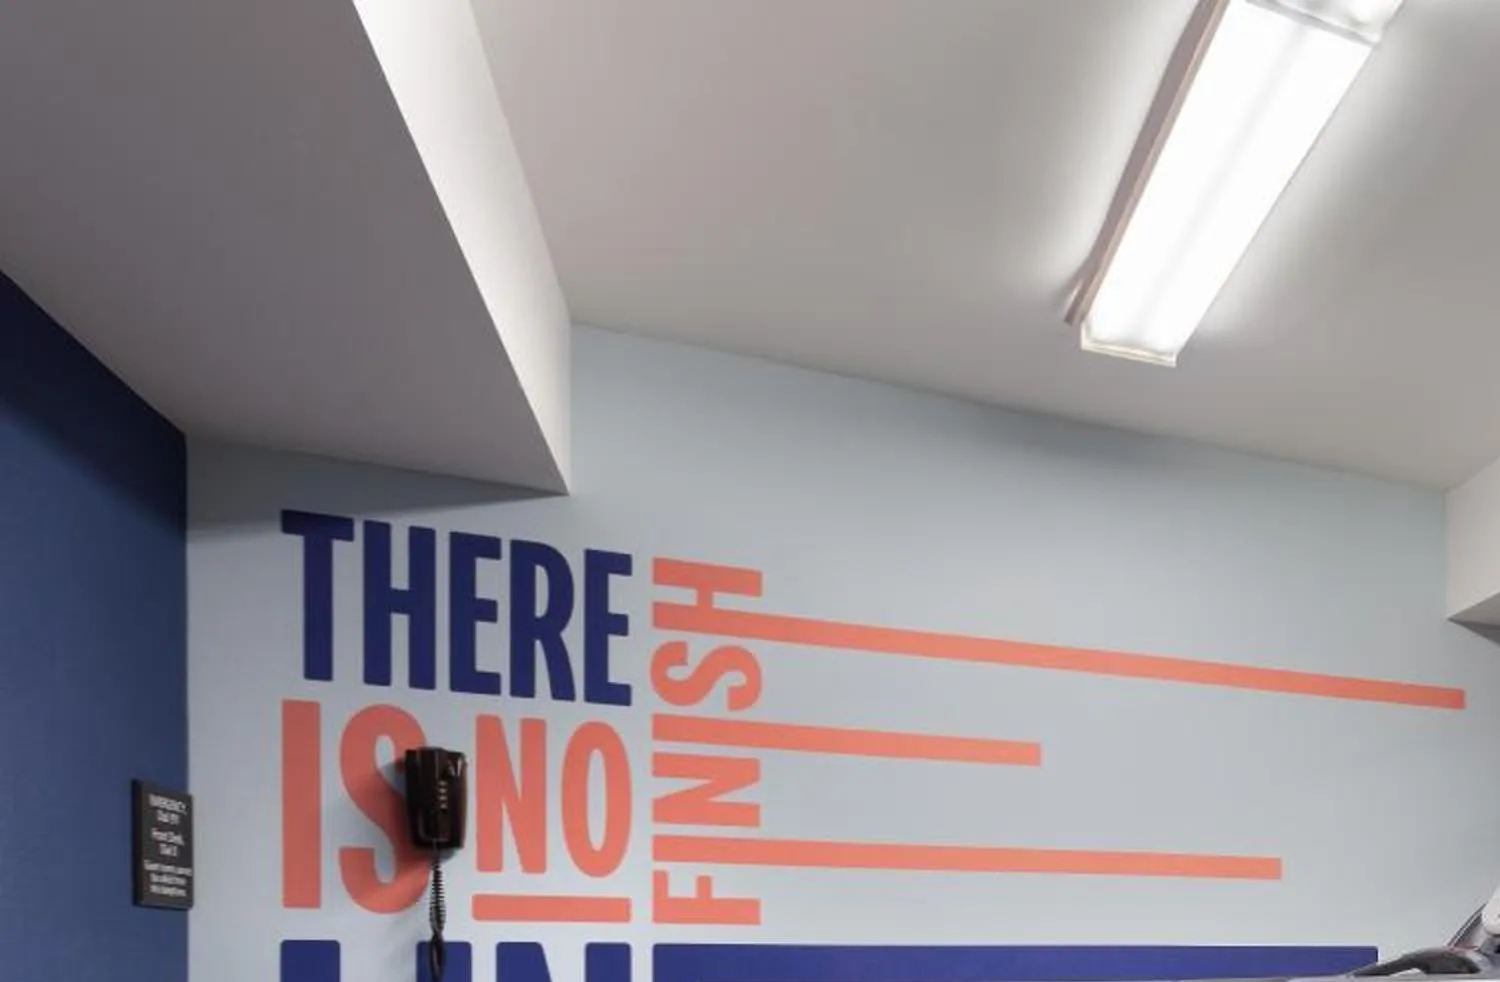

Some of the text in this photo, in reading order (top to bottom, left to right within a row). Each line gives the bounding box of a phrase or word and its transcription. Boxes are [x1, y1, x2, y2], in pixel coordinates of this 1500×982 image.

[281, 509, 632, 707] THERE
[281, 699, 632, 915] IS NO
